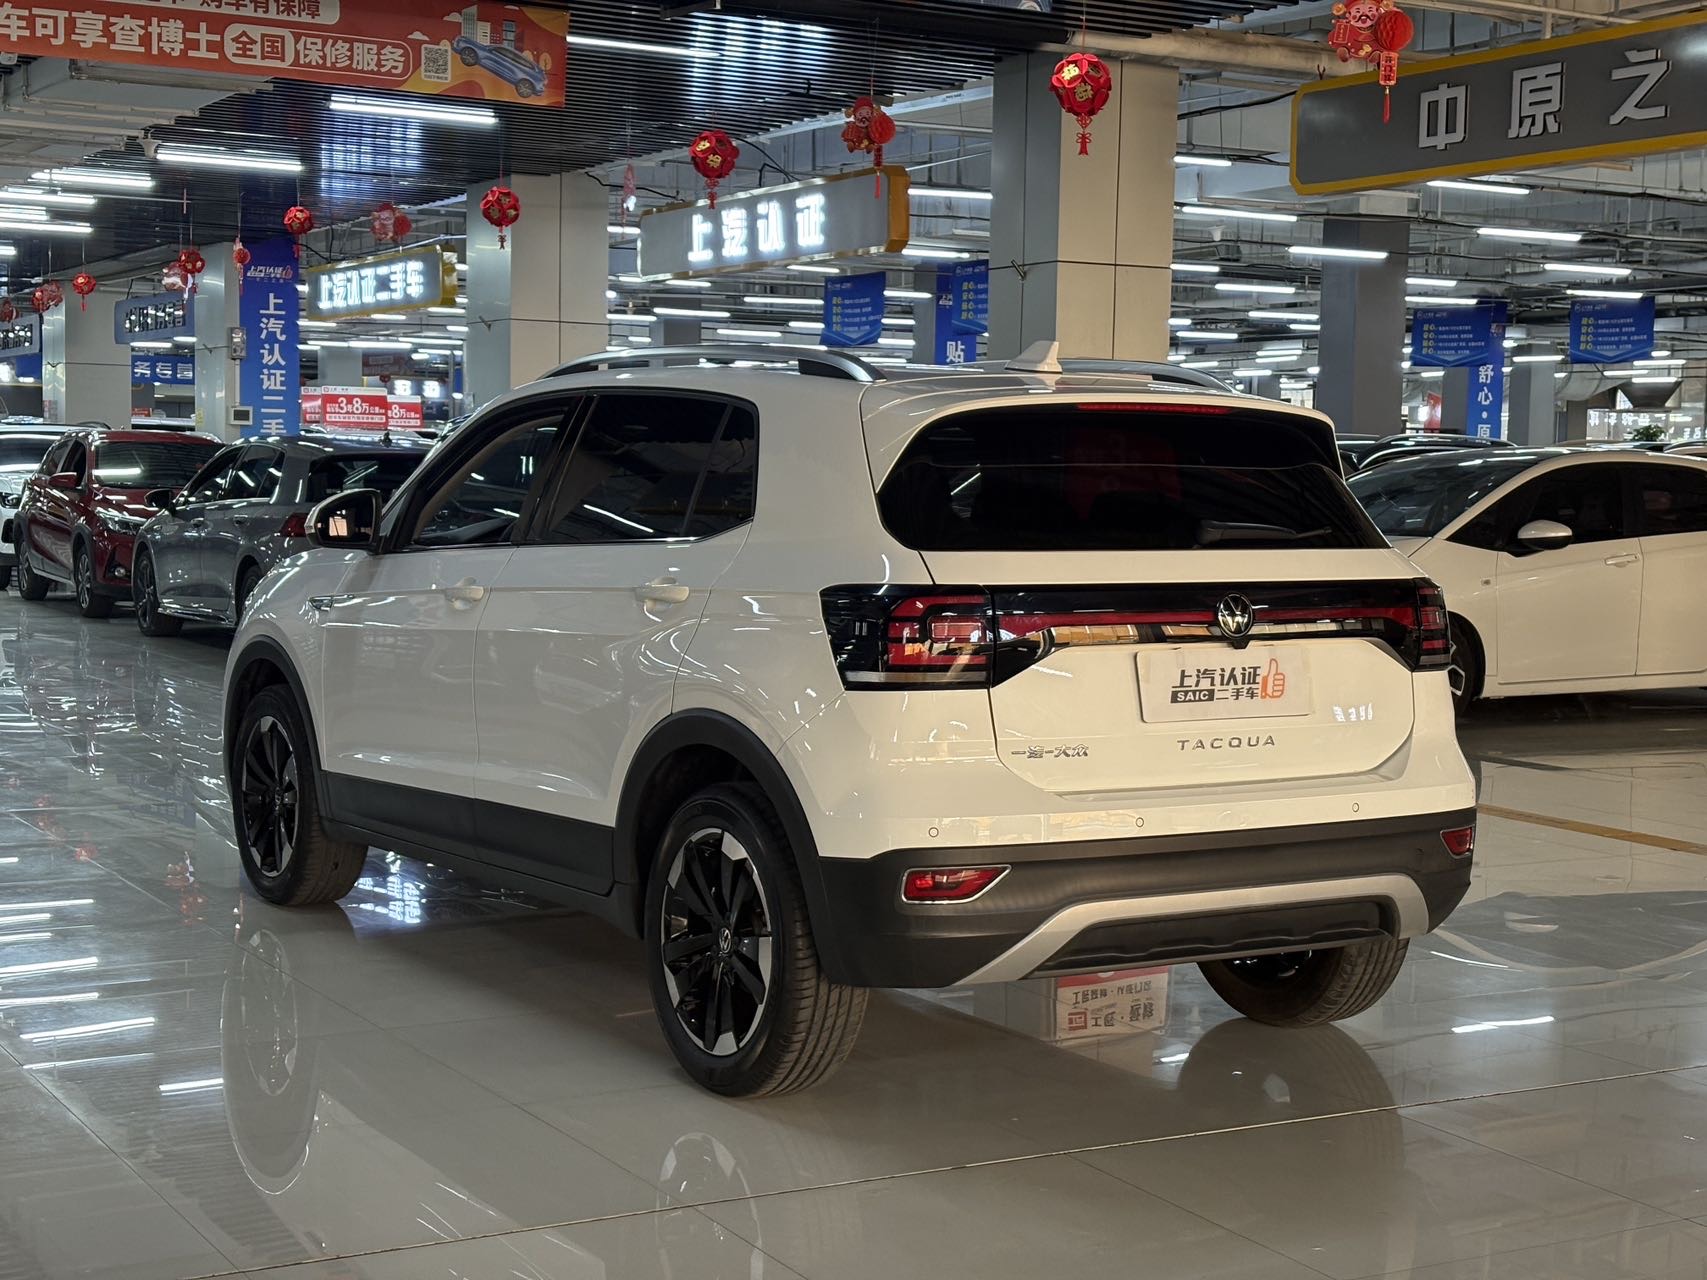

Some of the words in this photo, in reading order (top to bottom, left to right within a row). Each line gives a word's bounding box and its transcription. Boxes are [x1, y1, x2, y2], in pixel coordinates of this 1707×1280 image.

[1418, 48, 1671, 150] 中原之
[687, 192, 826, 262] 上汽认证
[317, 260, 425, 309] 上汽认证二手车
[259, 293, 287, 435] 上汽认证二手
[1172, 666, 1261, 689] 上汽认证
[1176, 690, 1209, 701] SAIC
[1215, 687, 1259, 700] 二手车
[1177, 735, 1275, 751] TACQUA
